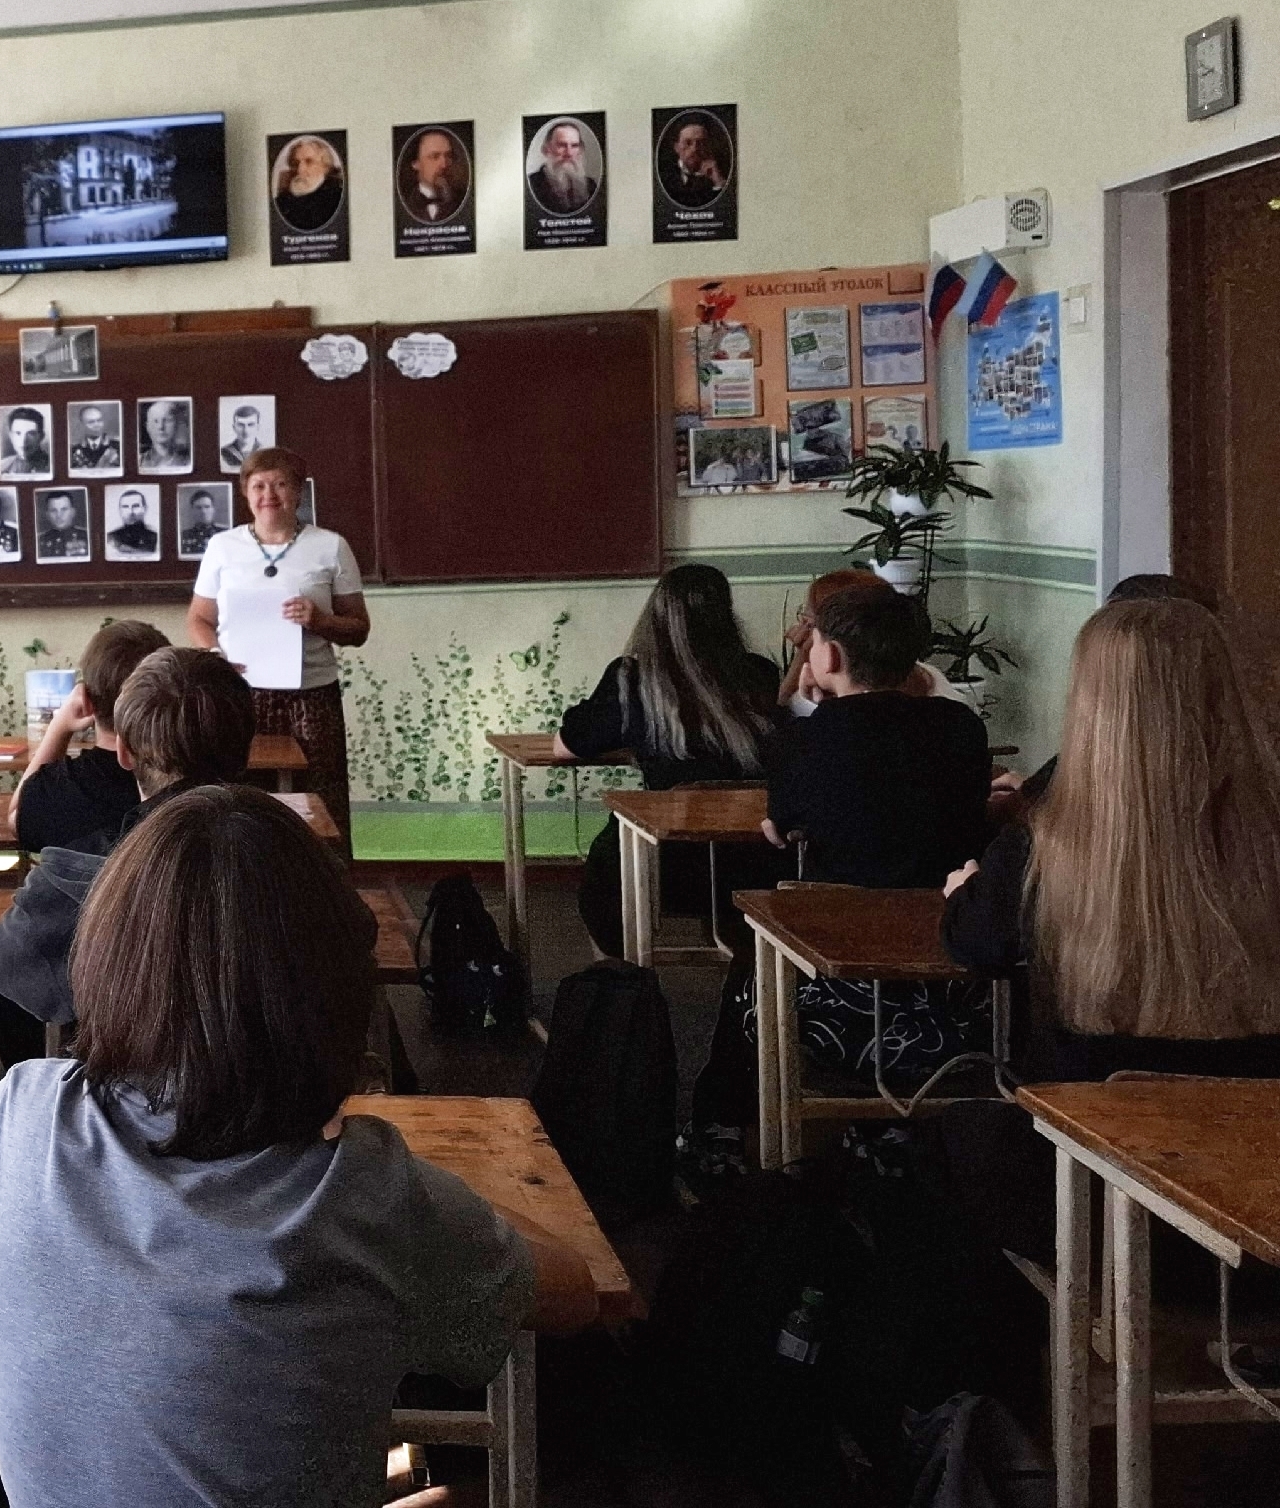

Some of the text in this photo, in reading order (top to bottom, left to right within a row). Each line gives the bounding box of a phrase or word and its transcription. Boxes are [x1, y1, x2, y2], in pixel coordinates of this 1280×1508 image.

[538, 215, 592, 227] Толстой
[403, 225, 467, 236] Некрасов
[745, 276, 884, 296] КЛАССНЫЙ УГОЛОК
